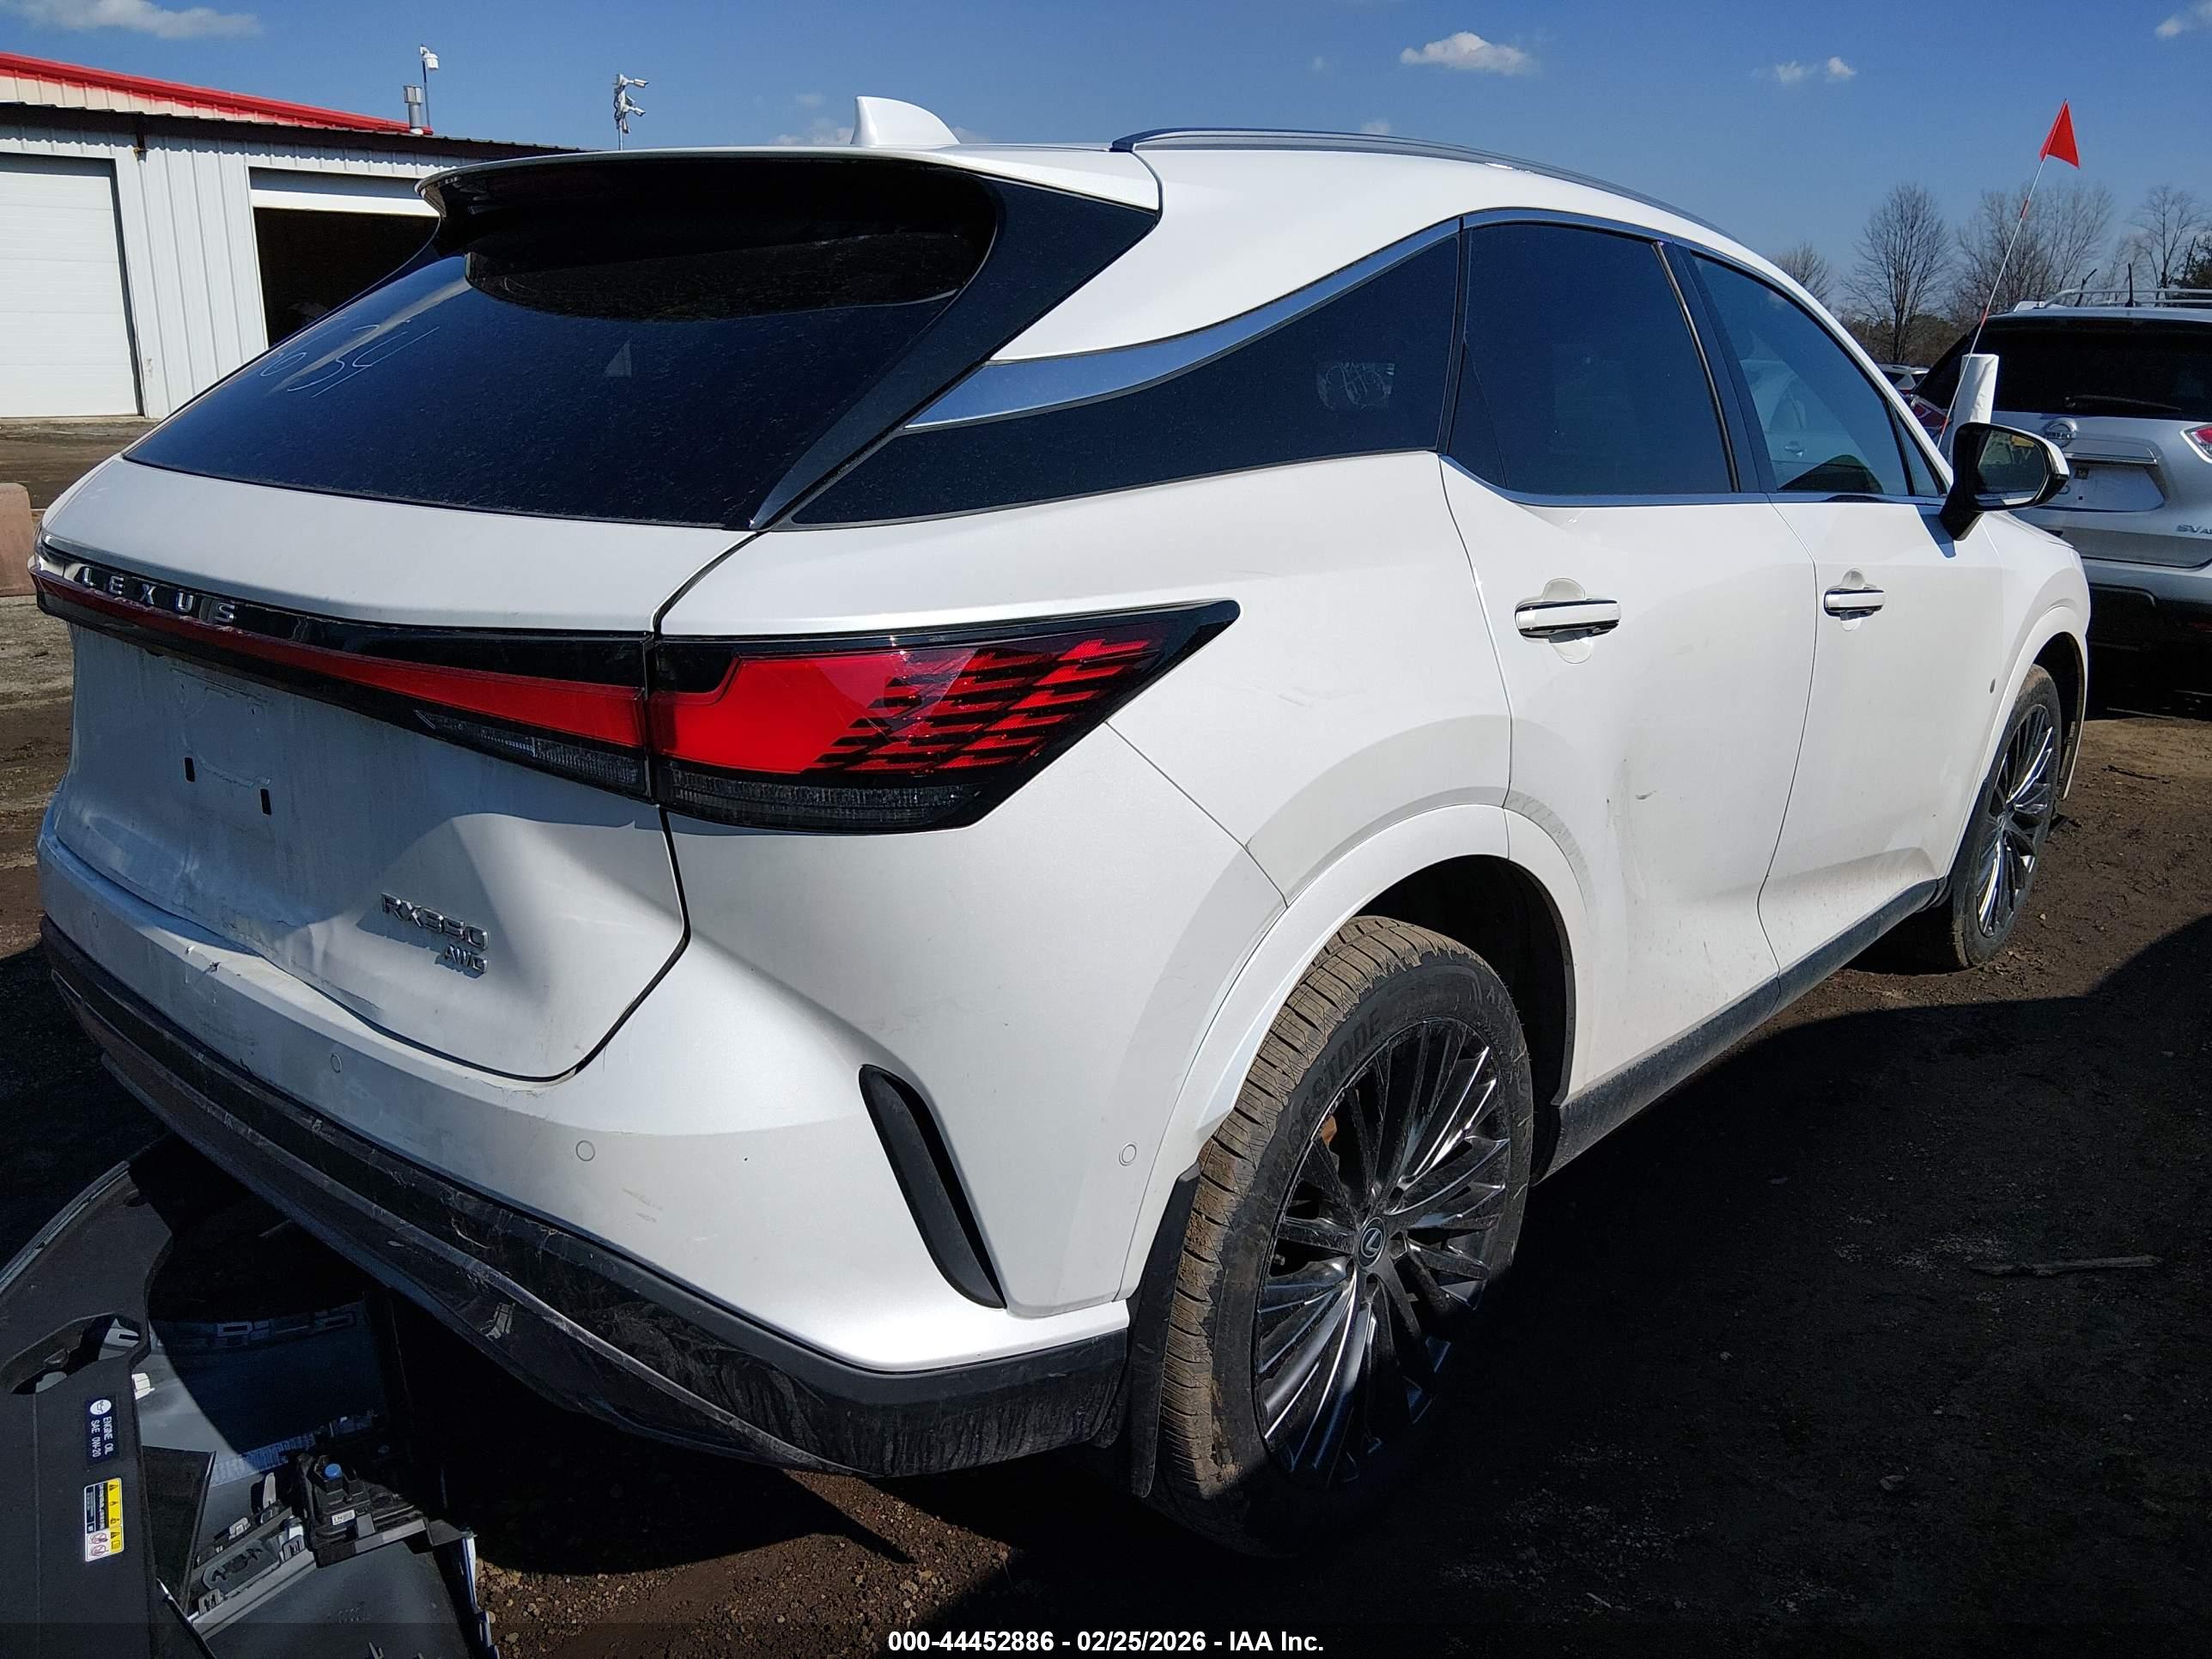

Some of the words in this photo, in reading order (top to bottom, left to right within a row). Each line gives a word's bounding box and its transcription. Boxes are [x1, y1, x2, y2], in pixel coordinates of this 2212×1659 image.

[83, 567, 236, 623] LEXUS
[380, 892, 489, 951] RX350
[444, 944, 488, 973] AWD
[91, 1419, 100, 1434] SAE
[103, 1416, 113, 1441] ENGINE
[91, 1437, 101, 1458] 0W-20
[104, 1443, 114, 1455] OIL
